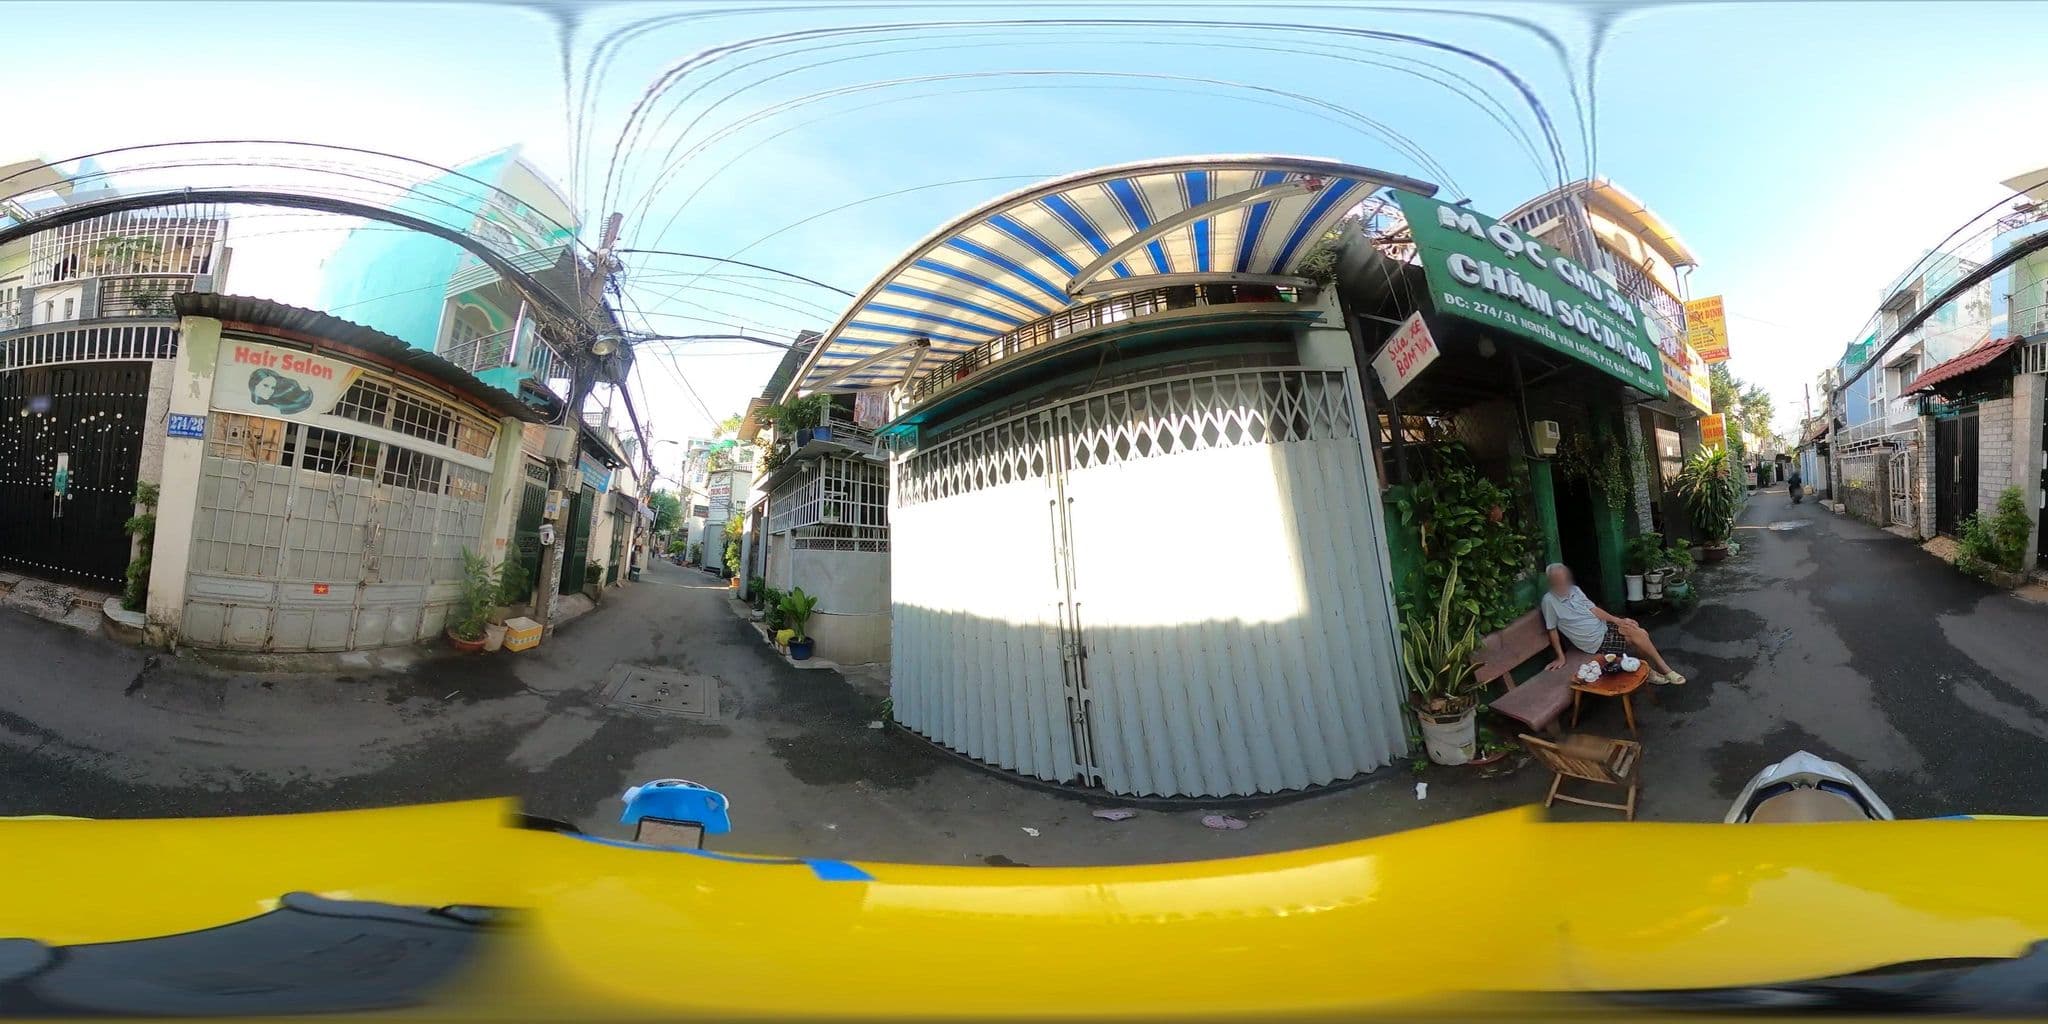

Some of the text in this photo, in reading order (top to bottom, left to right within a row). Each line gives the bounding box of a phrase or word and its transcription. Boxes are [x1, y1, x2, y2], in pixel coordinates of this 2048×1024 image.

[1438, 205, 1637, 328] MỘC CHU SPA
[1473, 301, 1518, 325] 274/31
[1555, 299, 1602, 342] SÓC
[1601, 325, 1627, 357] DA
[1625, 341, 1652, 371] CAO
[234, 345, 334, 380] Hair Salon
[169, 415, 204, 432] 274/28
